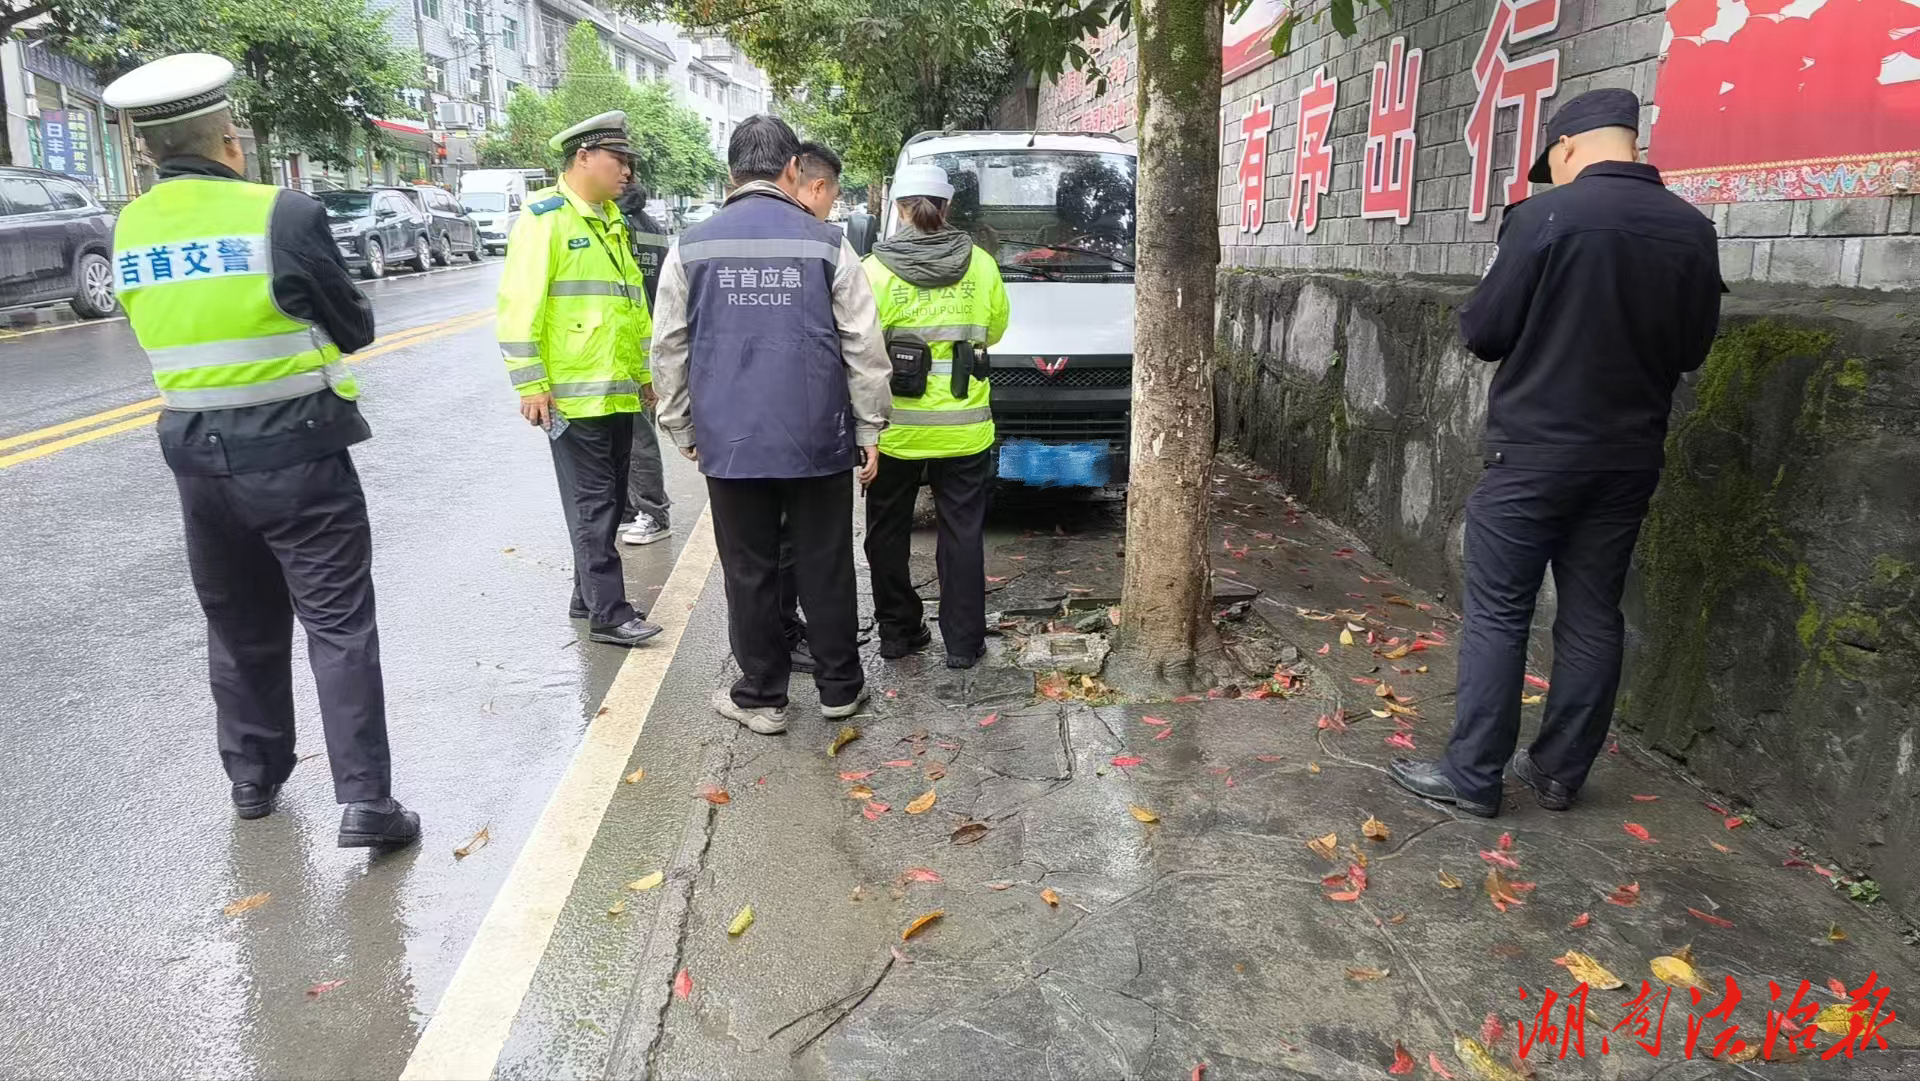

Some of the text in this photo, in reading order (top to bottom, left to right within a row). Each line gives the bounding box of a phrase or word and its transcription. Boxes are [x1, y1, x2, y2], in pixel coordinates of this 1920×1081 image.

[118, 238, 254, 286] 吉首交警
[716, 266, 802, 289] 吉首应急
[727, 293, 792, 306] RESCUE
[891, 279, 977, 306] 吉首公安
[897, 304, 973, 319] JISHOU POLICE
